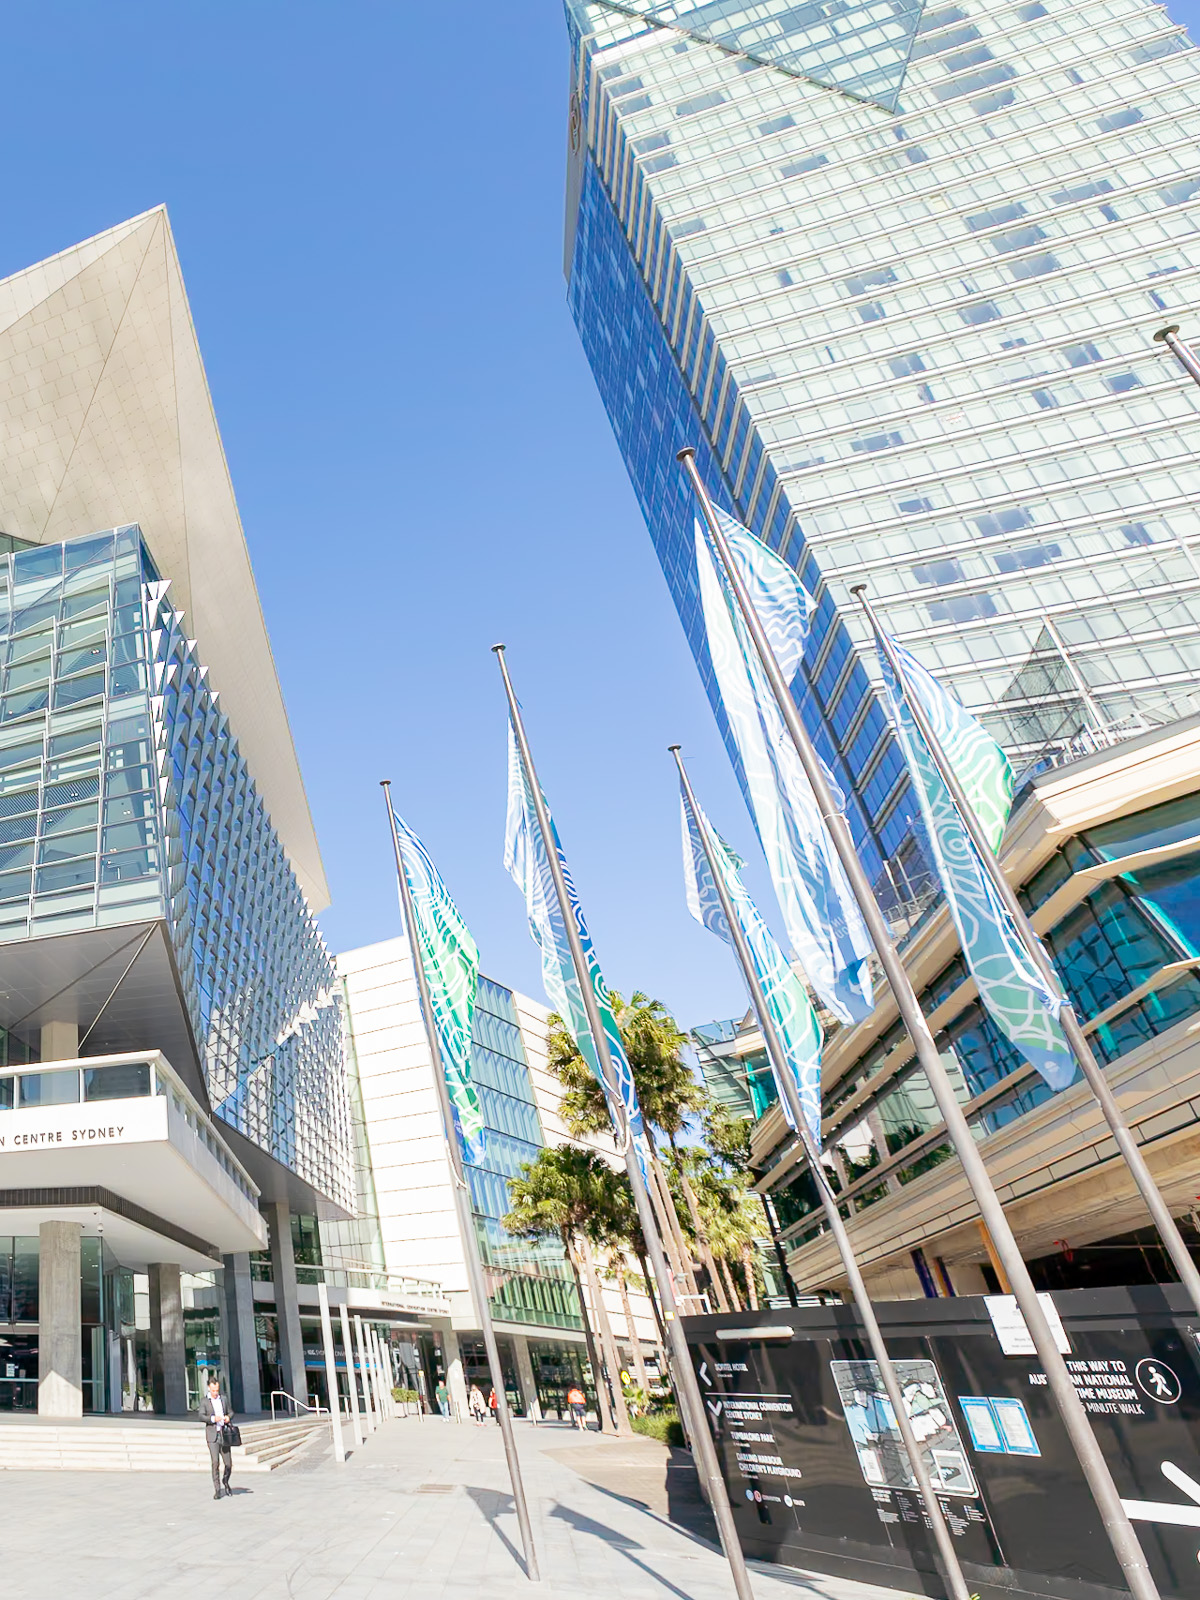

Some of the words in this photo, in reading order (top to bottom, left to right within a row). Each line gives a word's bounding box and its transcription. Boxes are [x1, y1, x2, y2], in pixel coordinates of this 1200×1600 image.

[13, 1131, 62, 1145] CENTRE
[72, 1126, 124, 1140] SYDNEY
[1066, 1360, 1088, 1371] THIS
[1087, 1360, 1110, 1371] WAY
[1109, 1360, 1126, 1371] TO
[1083, 1374, 1133, 1386] NATIONAL
[1095, 1388, 1139, 1400] MUSEUM
[1086, 1402, 1120, 1414] MINUTE
[1118, 1403, 1145, 1415] WALK
